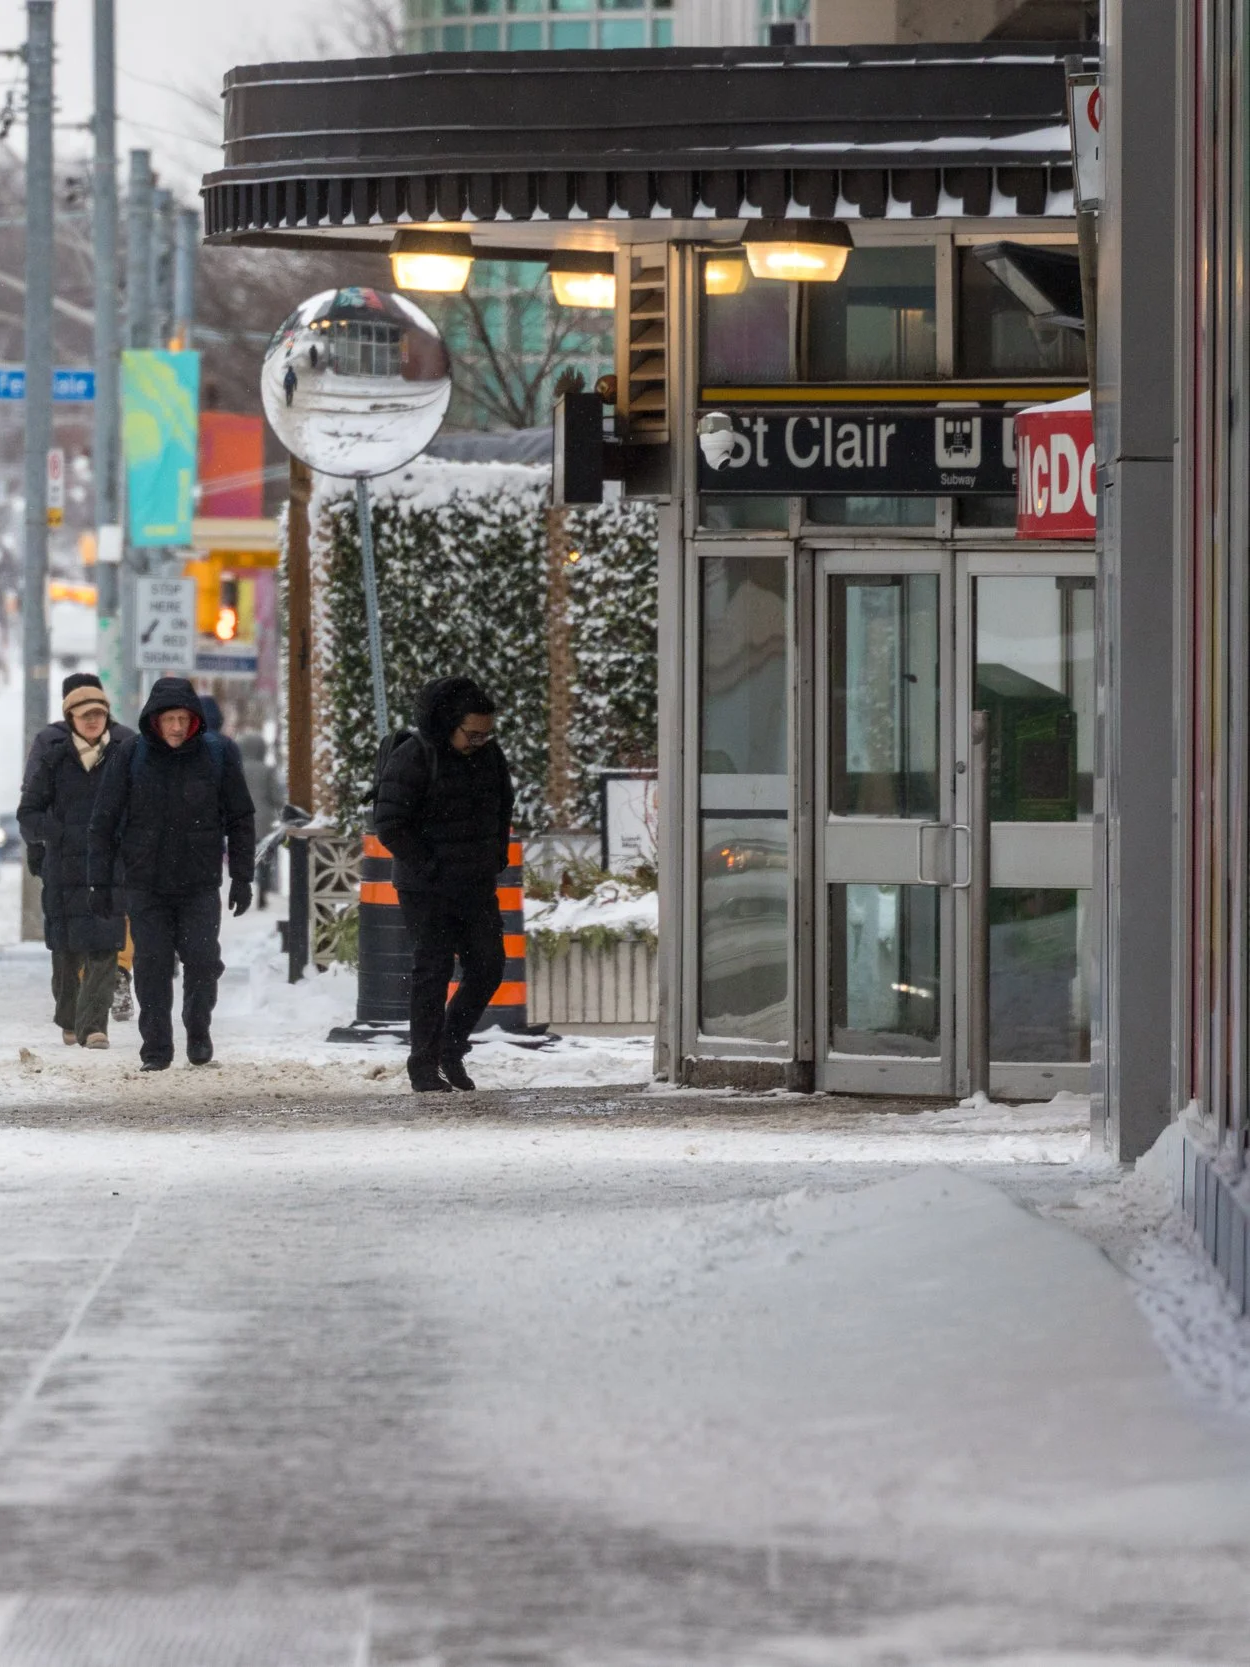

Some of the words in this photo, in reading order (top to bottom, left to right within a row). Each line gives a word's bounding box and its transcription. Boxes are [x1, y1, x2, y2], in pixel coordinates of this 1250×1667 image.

[784, 417, 896, 469] Clair
[940, 473, 976, 488] Subway
[150, 584, 183, 596] STOP
[150, 601, 182, 613] HERE
[170, 618, 188, 630] ON
[163, 635, 188, 647] RED
[143, 652, 186, 665] SIGNAL
